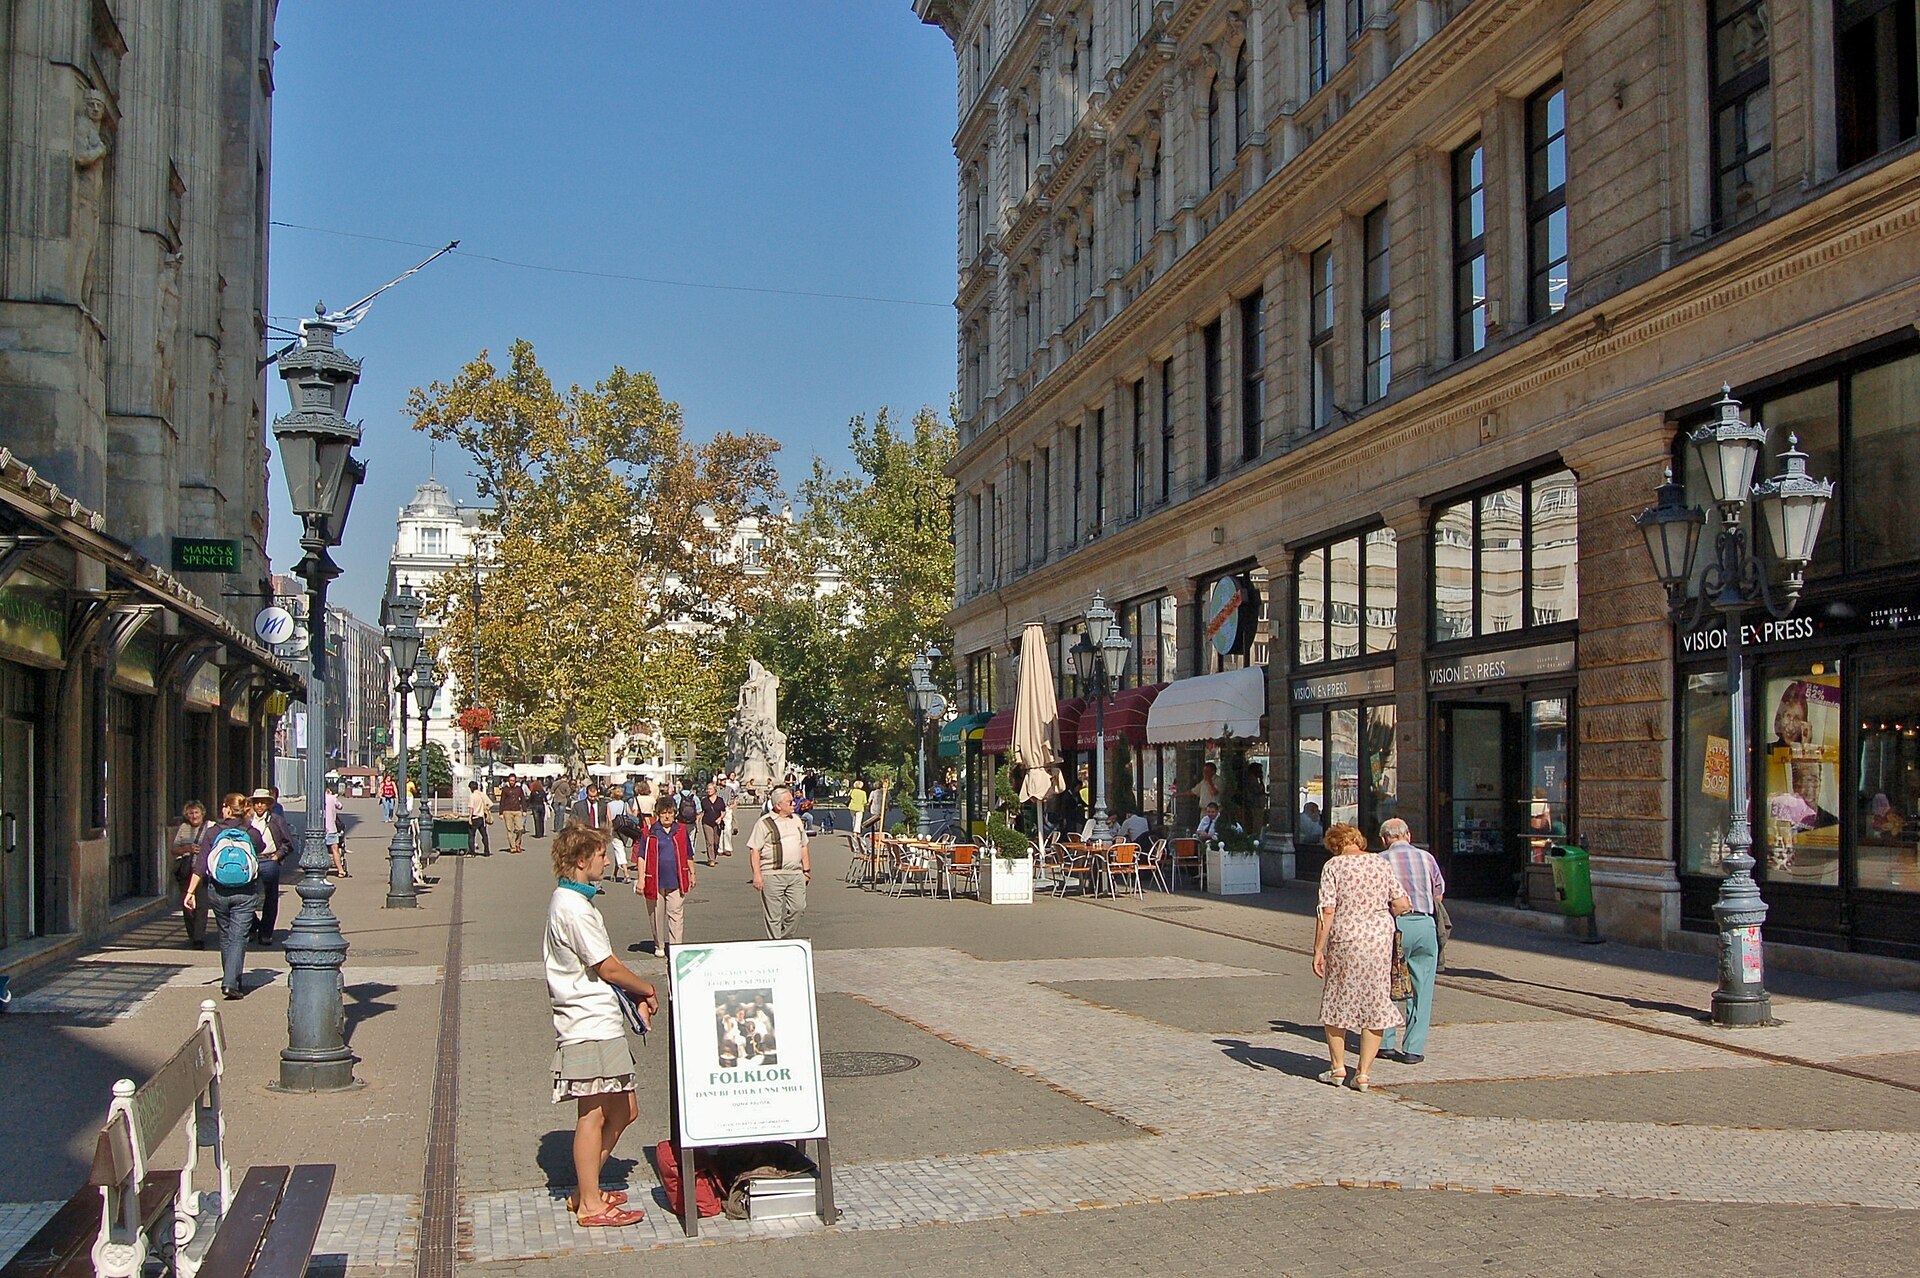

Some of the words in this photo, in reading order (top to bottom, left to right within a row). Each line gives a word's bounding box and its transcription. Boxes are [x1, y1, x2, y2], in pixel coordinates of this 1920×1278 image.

[182, 555, 234, 566] SPENCER
[1741, 617, 1813, 645] EXPRESS
[1429, 666, 1460, 684] VISION
[1293, 686, 1316, 700] VISION
[1703, 772, 1727, 793] 50%
[709, 1068, 792, 1085] FOLKLOR
